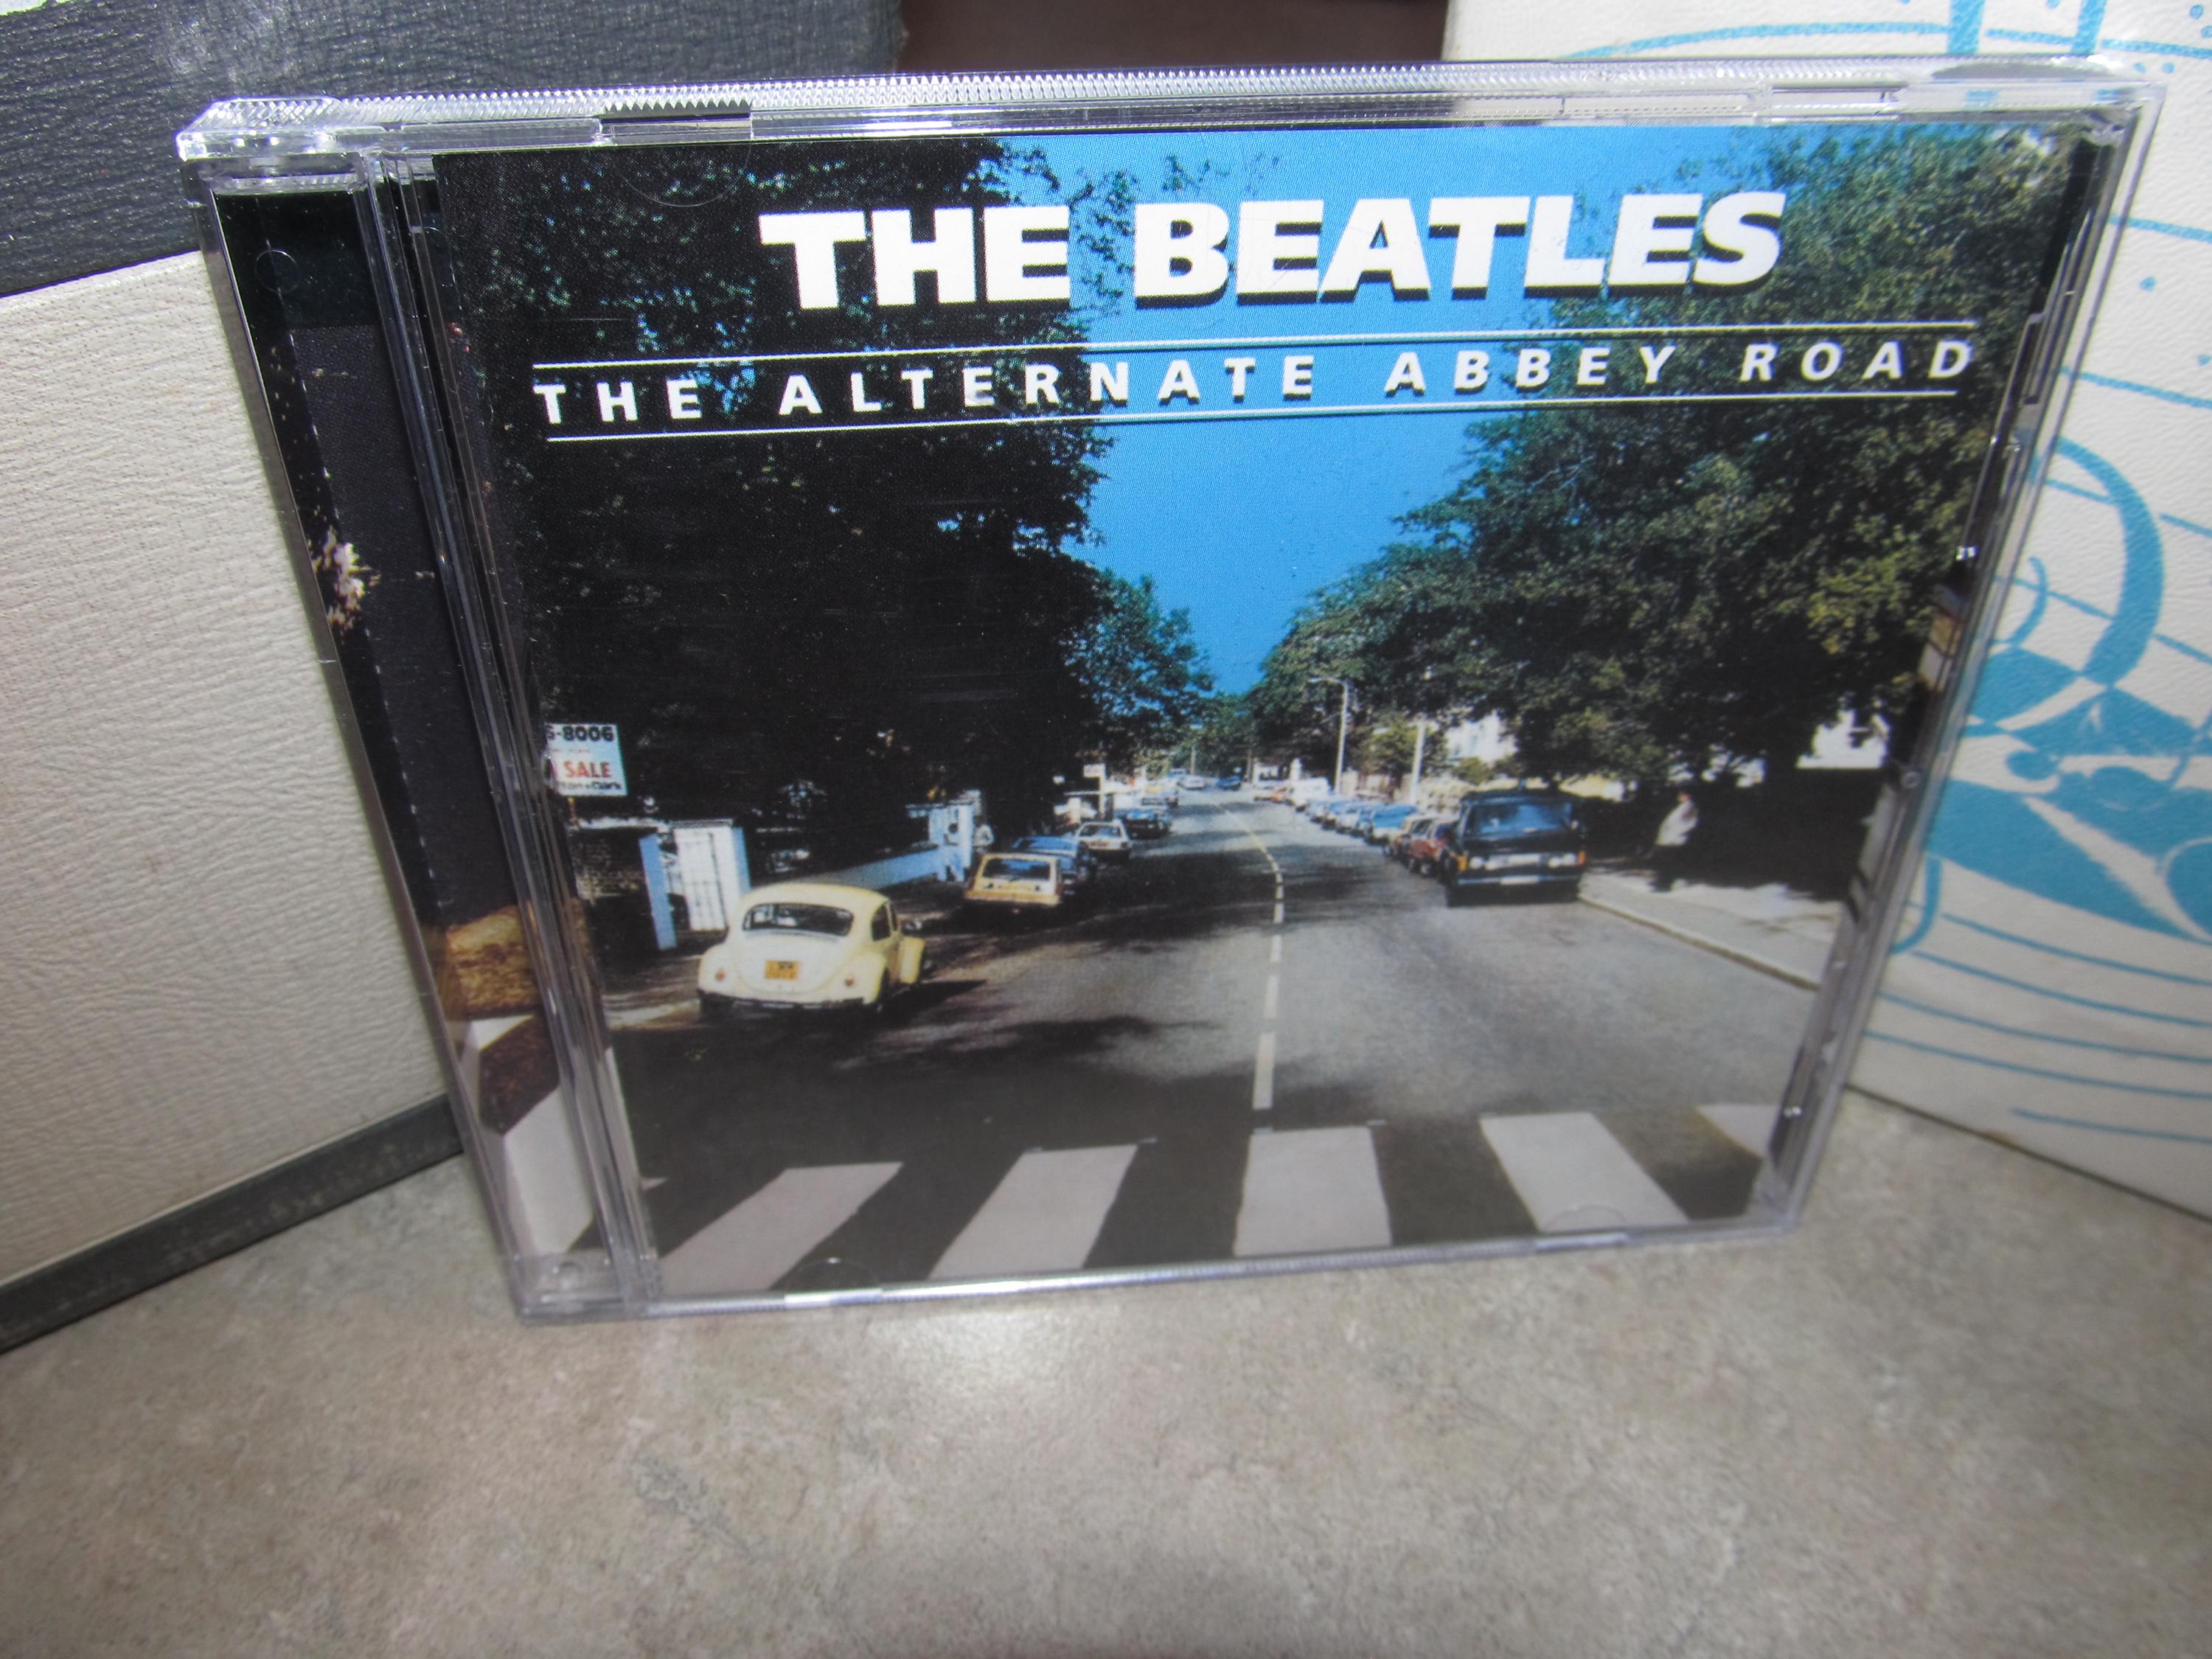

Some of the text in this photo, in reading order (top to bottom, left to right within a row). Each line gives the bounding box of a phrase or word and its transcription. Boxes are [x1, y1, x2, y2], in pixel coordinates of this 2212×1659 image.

[759, 192, 1786, 309] THE BEATLES
[533, 341, 1972, 423] THE ALTERNATE ABBEY ROAD
[563, 761, 611, 778] SALE
